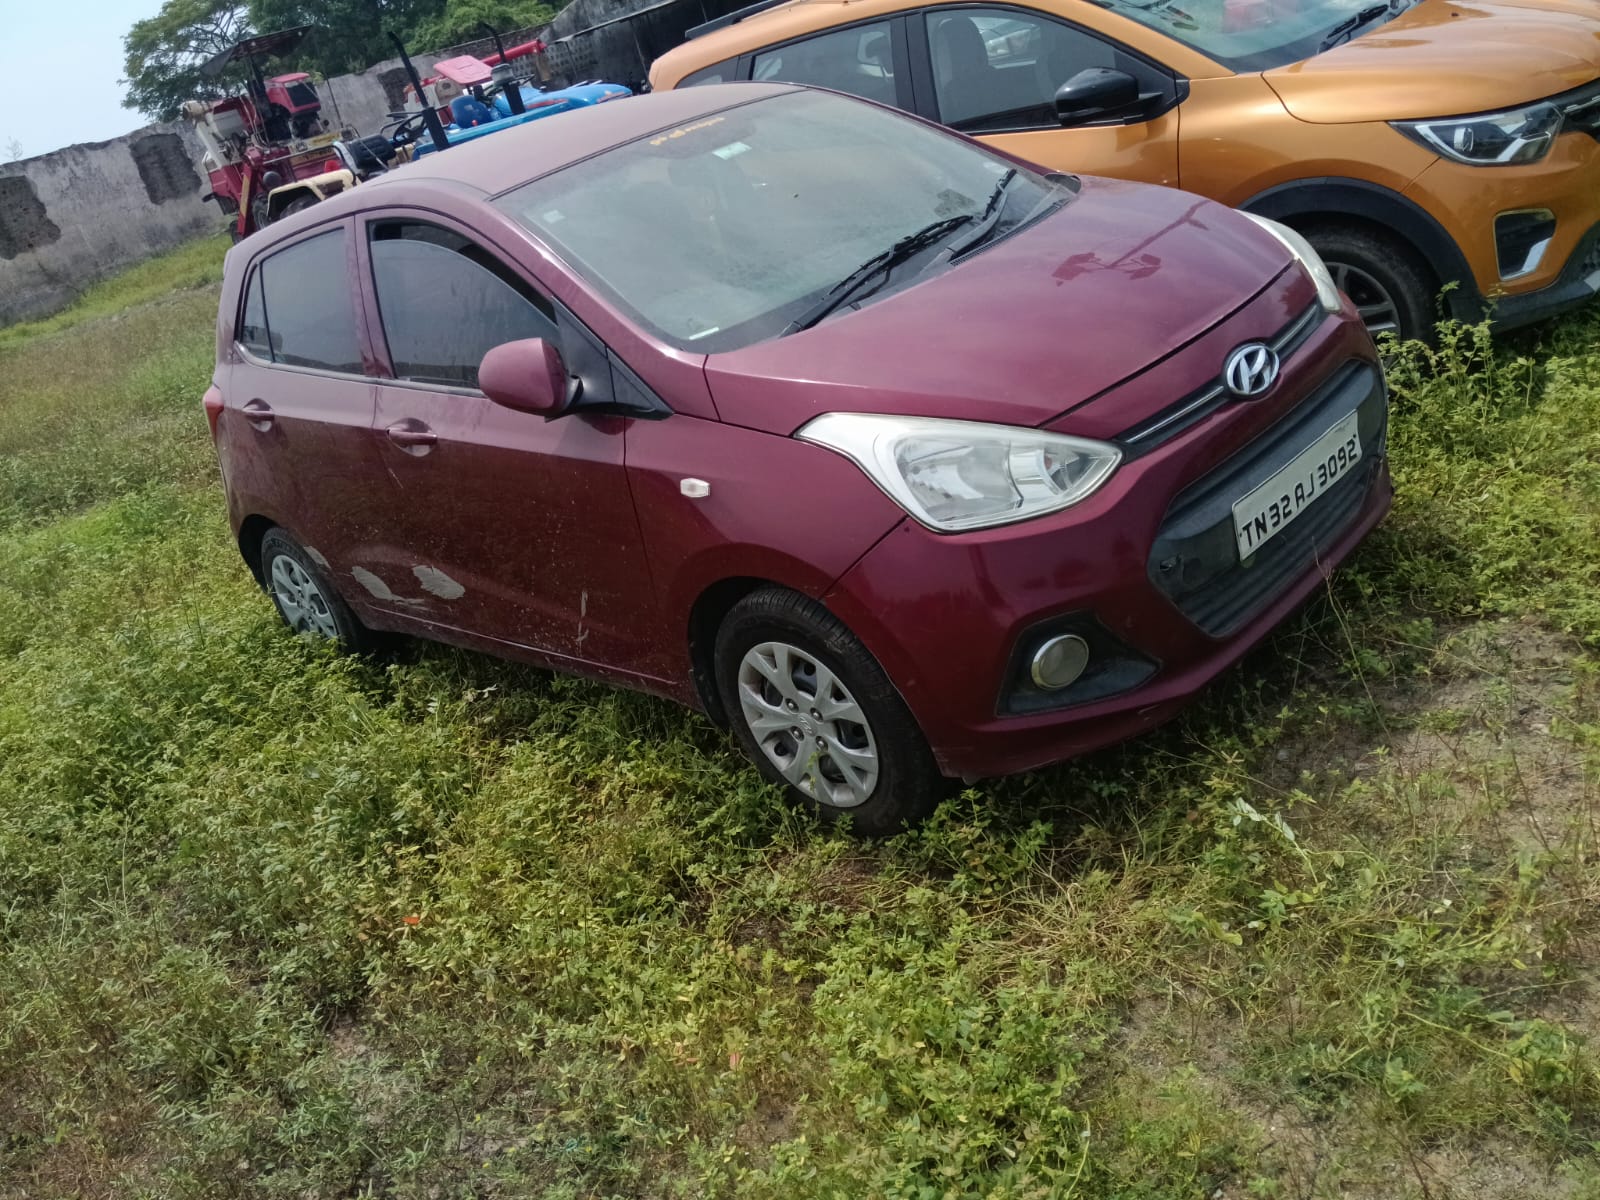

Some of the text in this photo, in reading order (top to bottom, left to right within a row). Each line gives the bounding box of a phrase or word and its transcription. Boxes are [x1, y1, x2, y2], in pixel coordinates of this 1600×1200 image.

[1242, 440, 1357, 547] TN 32 AJ 3092
